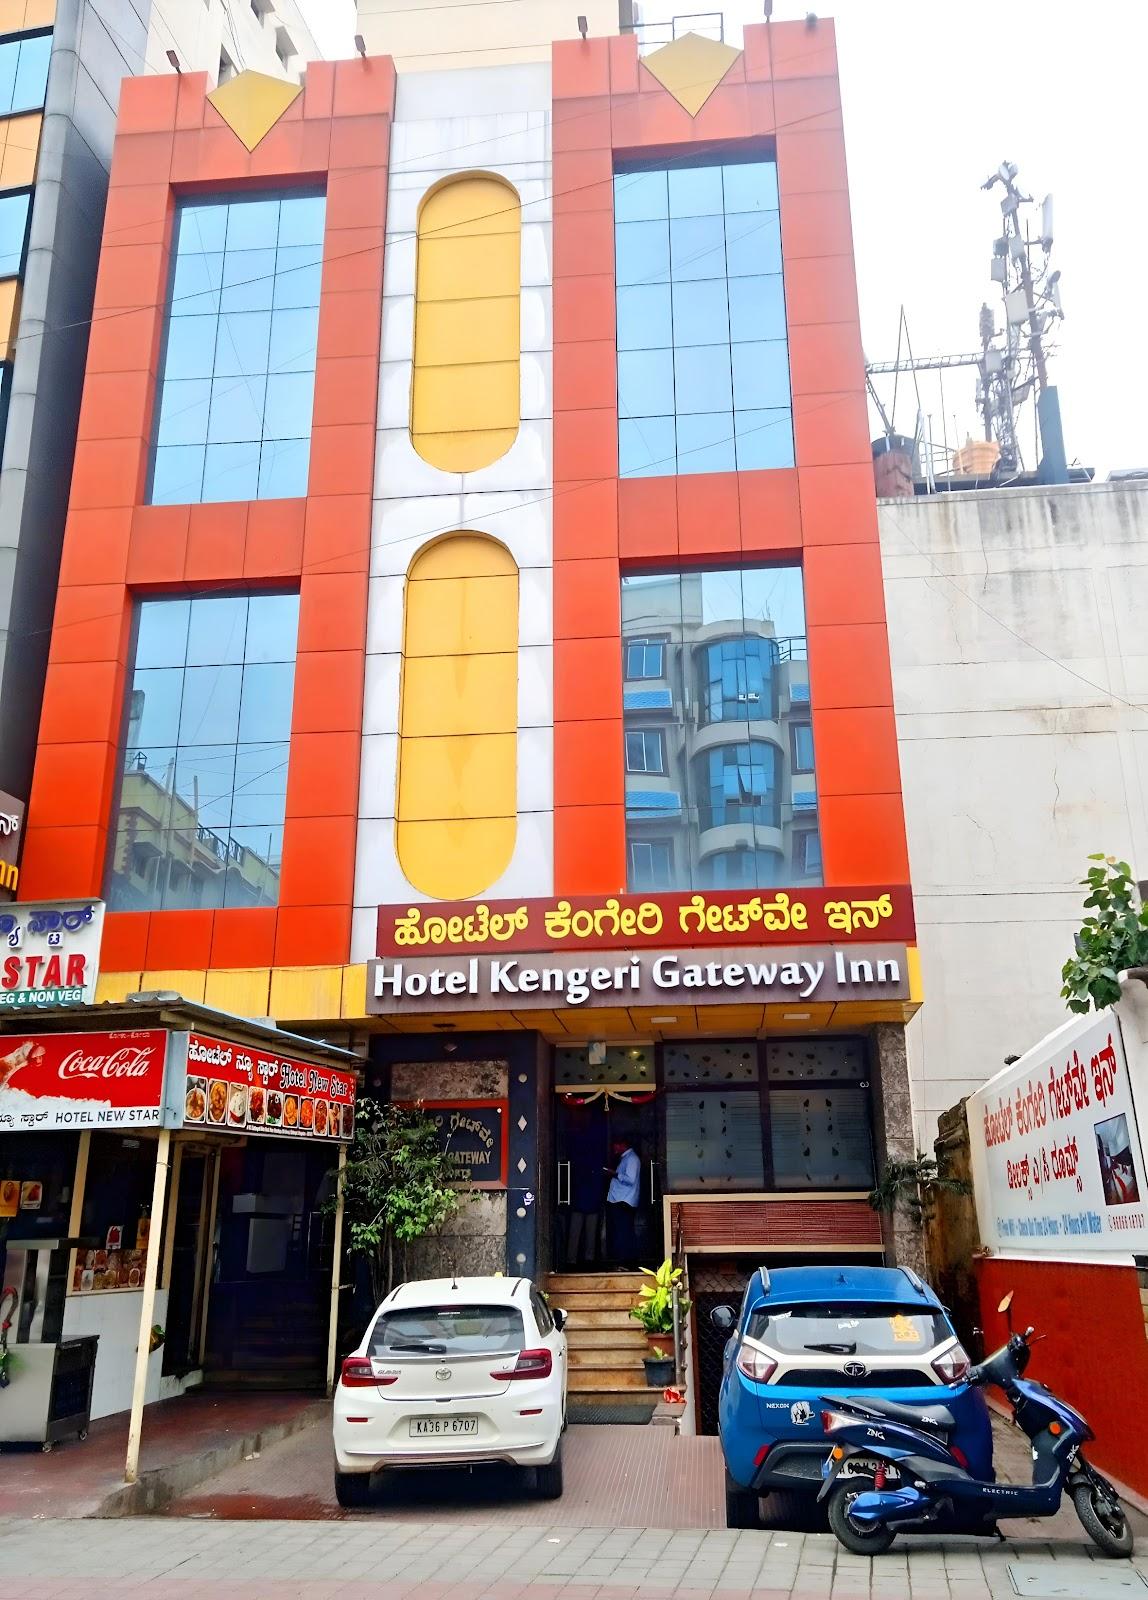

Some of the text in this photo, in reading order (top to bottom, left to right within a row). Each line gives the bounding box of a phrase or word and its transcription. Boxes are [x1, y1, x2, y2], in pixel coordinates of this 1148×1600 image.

[394, 904, 529, 945] ಹೋಟೆಲ್
[544, 898, 663, 939] ಕೆಂಗೇರಿ
[824, 893, 893, 935] ಇನ್
[2, 954, 86, 989] STAR
[373, 951, 900, 1005] Hotel Kengeri Gateway Inn
[18, 993, 28, 1003] &
[29, 991, 55, 1002] NON
[58, 990, 81, 1000] VEG
[58, 1047, 156, 1079] Coca-Cola
[188, 1040, 232, 1066] ಹೋಟೆಲ್
[280, 1062, 307, 1089] Hotel
[308, 1070, 329, 1094] New
[330, 1074, 348, 1098] Star
[1090, 1033, 1117, 1107] ಇನ್
[56, 1109, 160, 1123] HOTEL NEW STAR
[443, 1421, 449, 1432] P
[452, 1420, 476, 1432] 6707
[921, 1416, 939, 1426] ZING
[866, 1428, 886, 1441] ZING
[982, 1487, 1019, 1496] ELECTRIC
